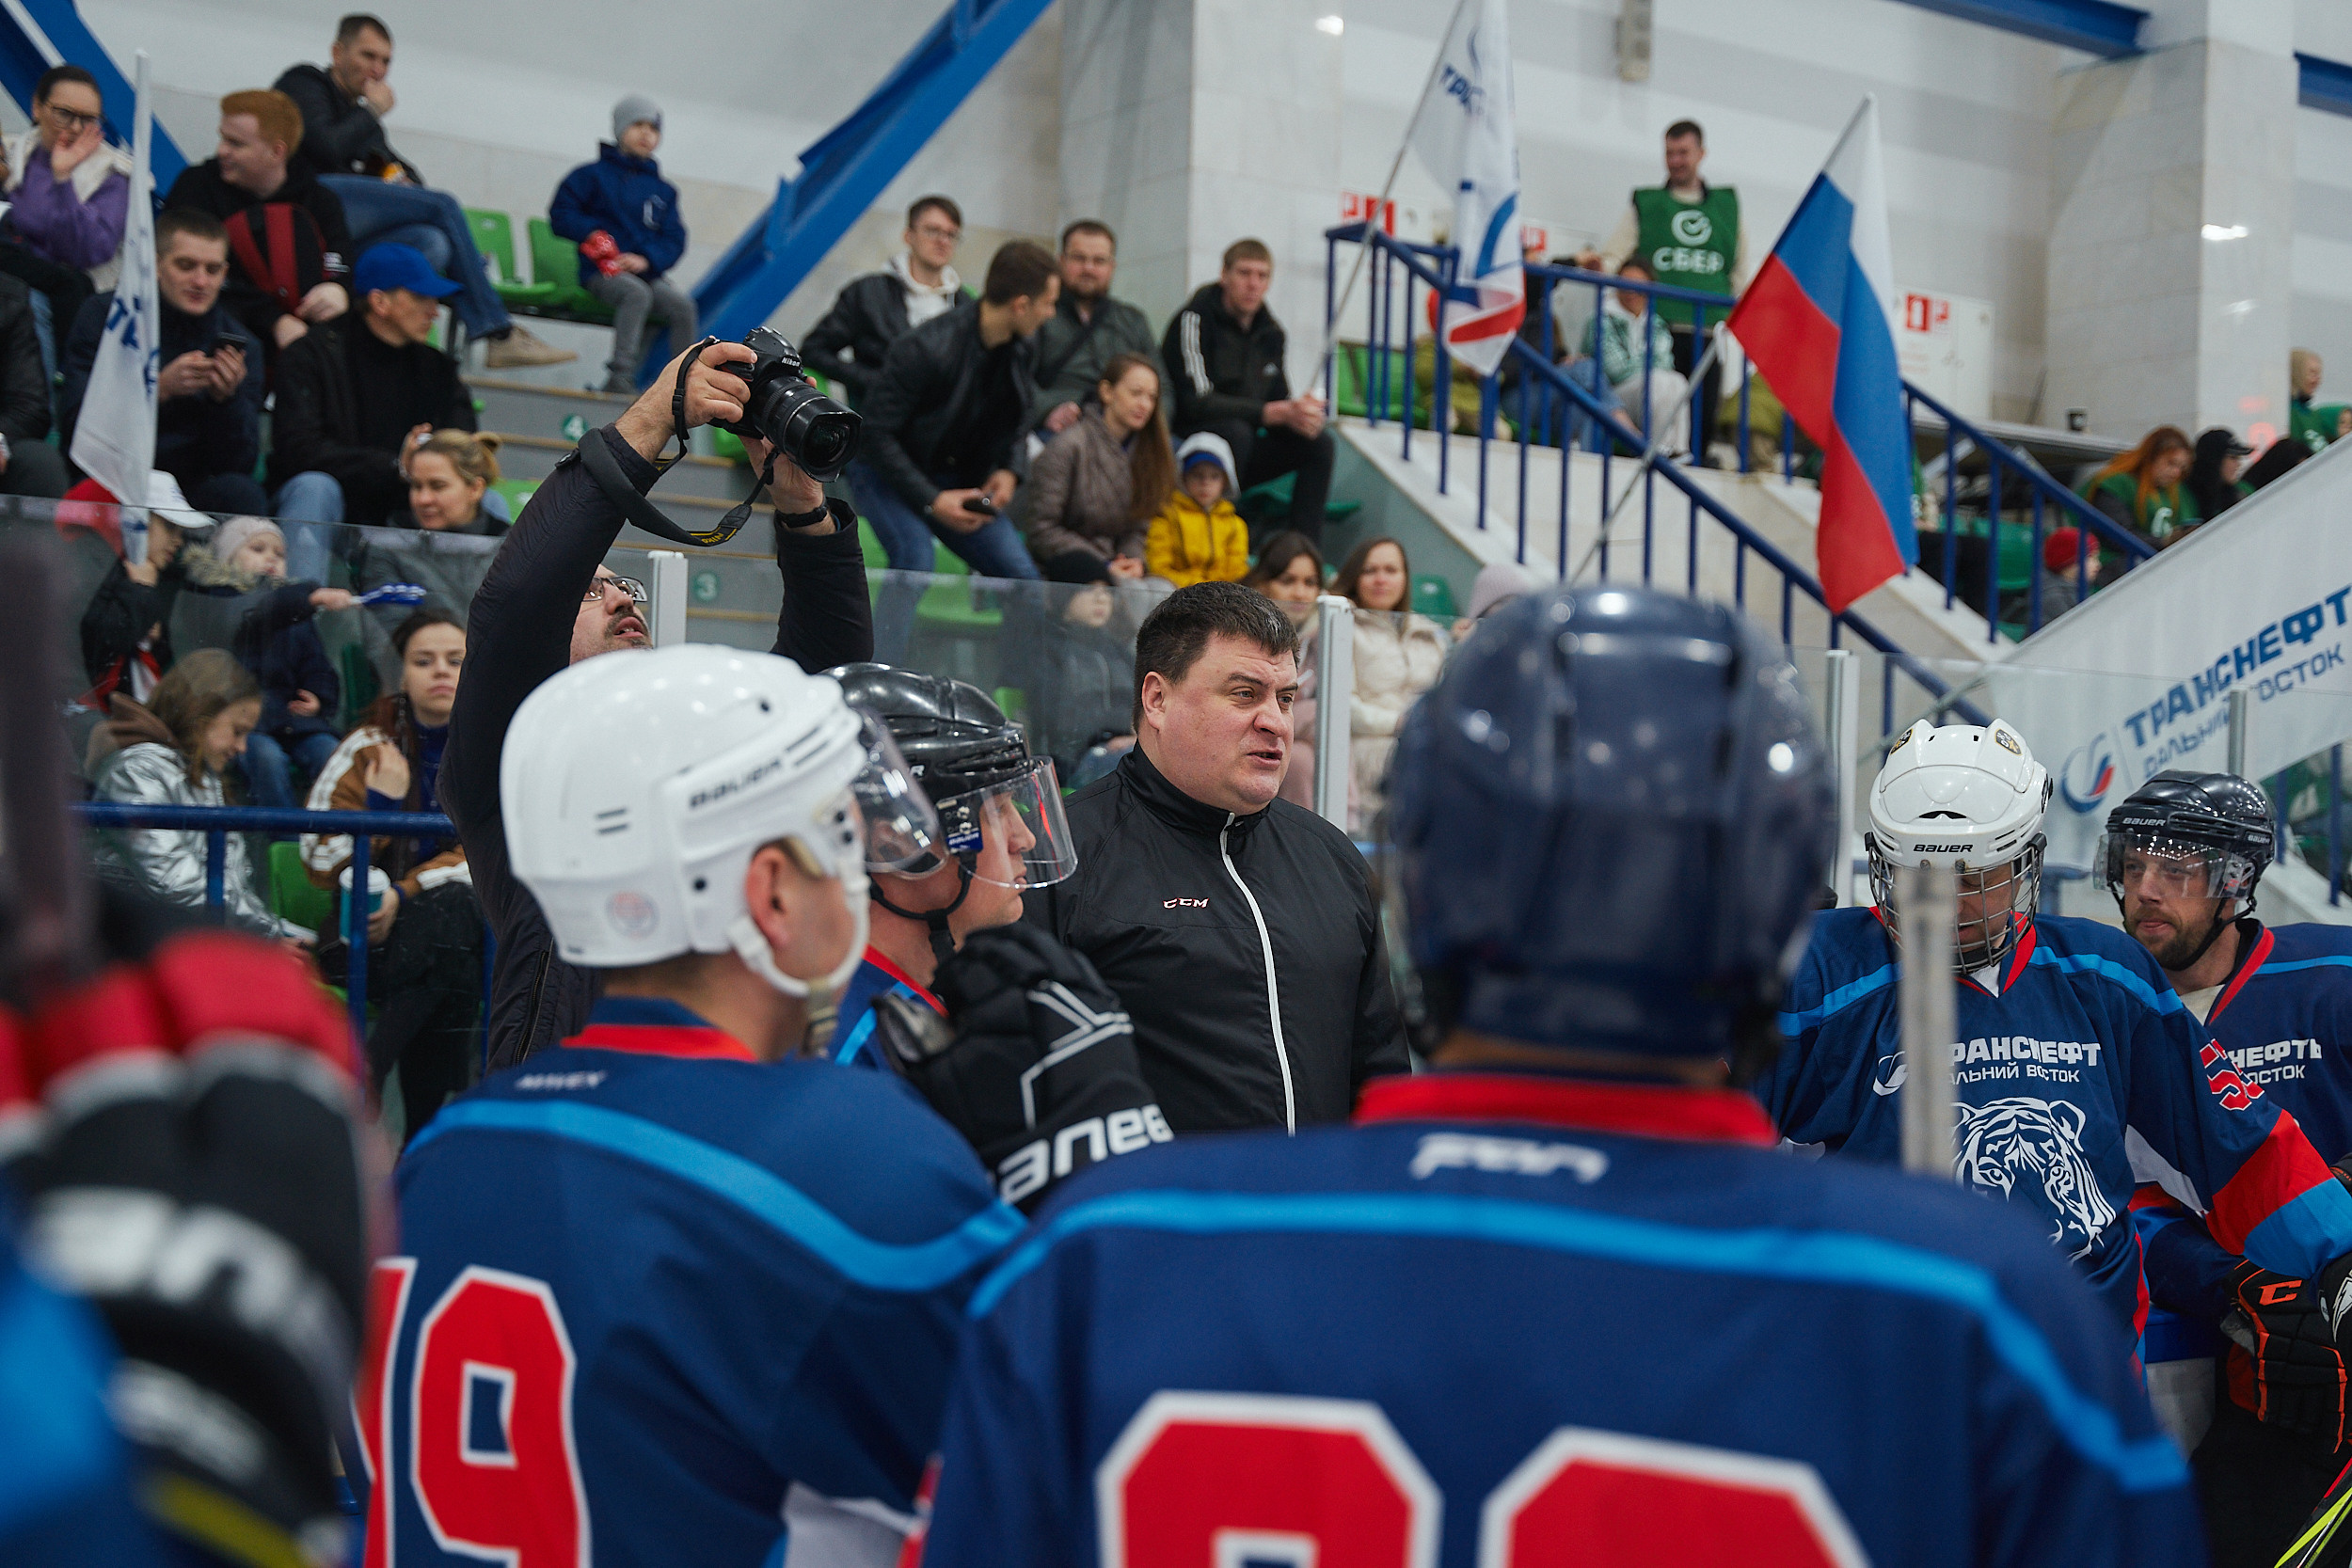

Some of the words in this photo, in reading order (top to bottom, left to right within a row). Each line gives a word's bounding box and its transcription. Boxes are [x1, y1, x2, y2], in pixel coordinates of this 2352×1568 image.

[1652, 246, 1724, 275] СБЕР
[782, 357, 800, 367] Nikon
[565, 415, 583, 438] 4
[701, 532, 724, 544] Niko
[697, 574, 717, 600] 3
[2249, 643, 2344, 701] ОСТОК
[1163, 897, 1209, 909] CCM
[1947, 1036, 2102, 1067] РАНСНЕФТ
[2247, 1064, 2305, 1085] ОСТОК
